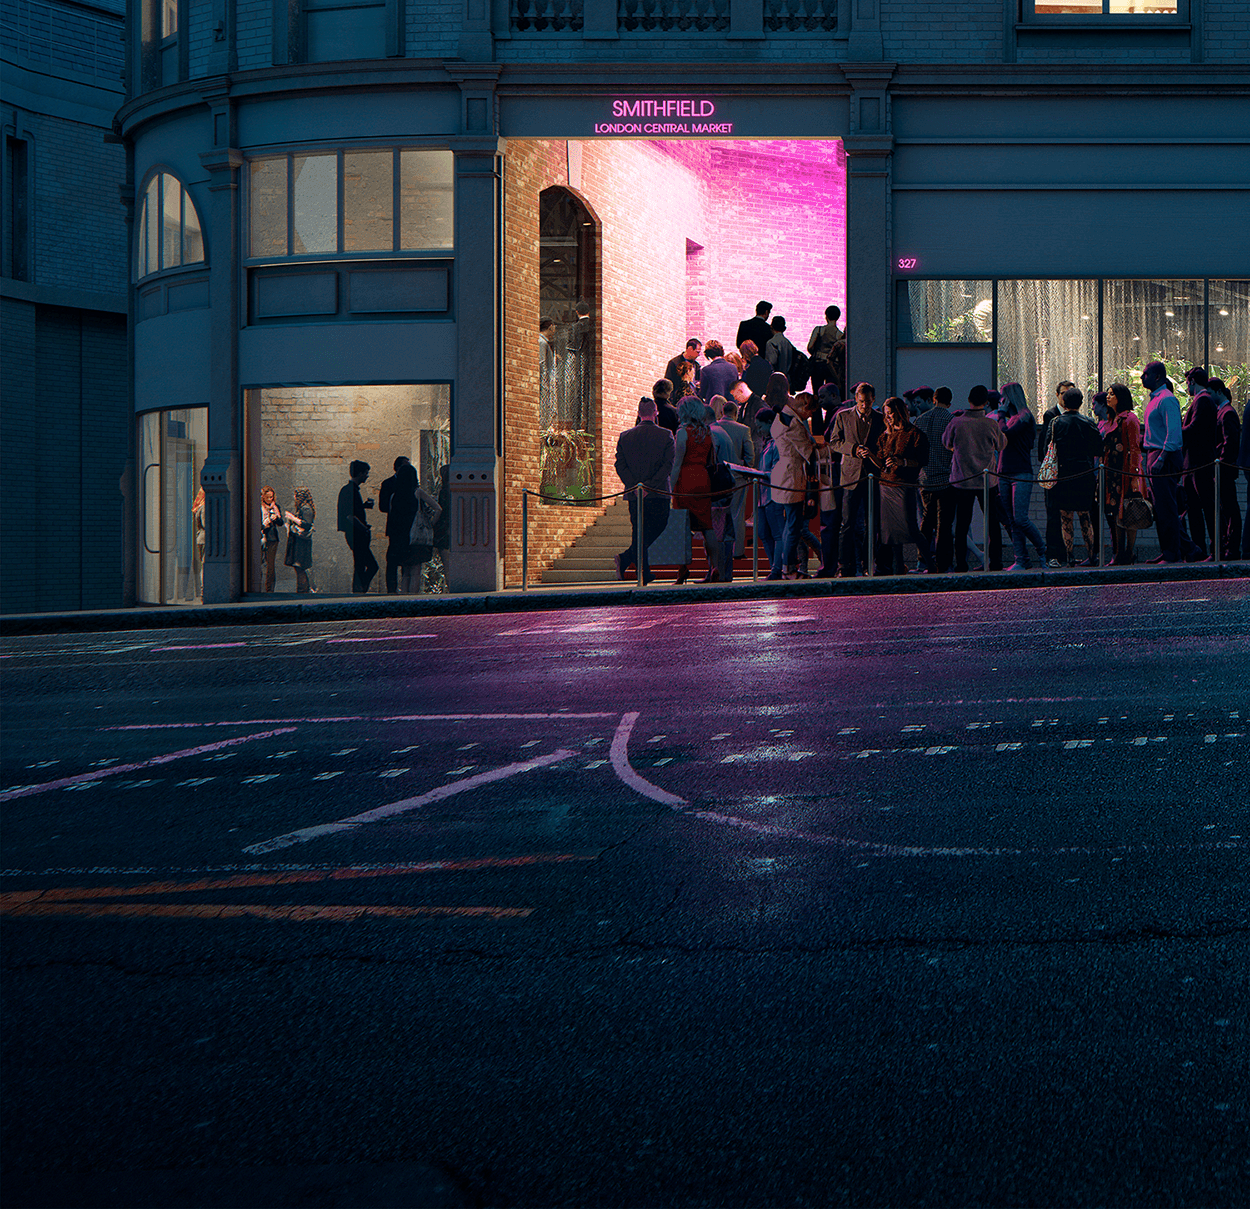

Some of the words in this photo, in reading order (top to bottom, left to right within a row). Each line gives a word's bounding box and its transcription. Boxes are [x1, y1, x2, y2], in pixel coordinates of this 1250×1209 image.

[612, 100, 715, 117] SMITHFIELD
[594, 123, 642, 134] LONDON
[643, 123, 690, 134] CENTRAL
[692, 123, 733, 134] MARKET
[898, 258, 917, 269] 327
